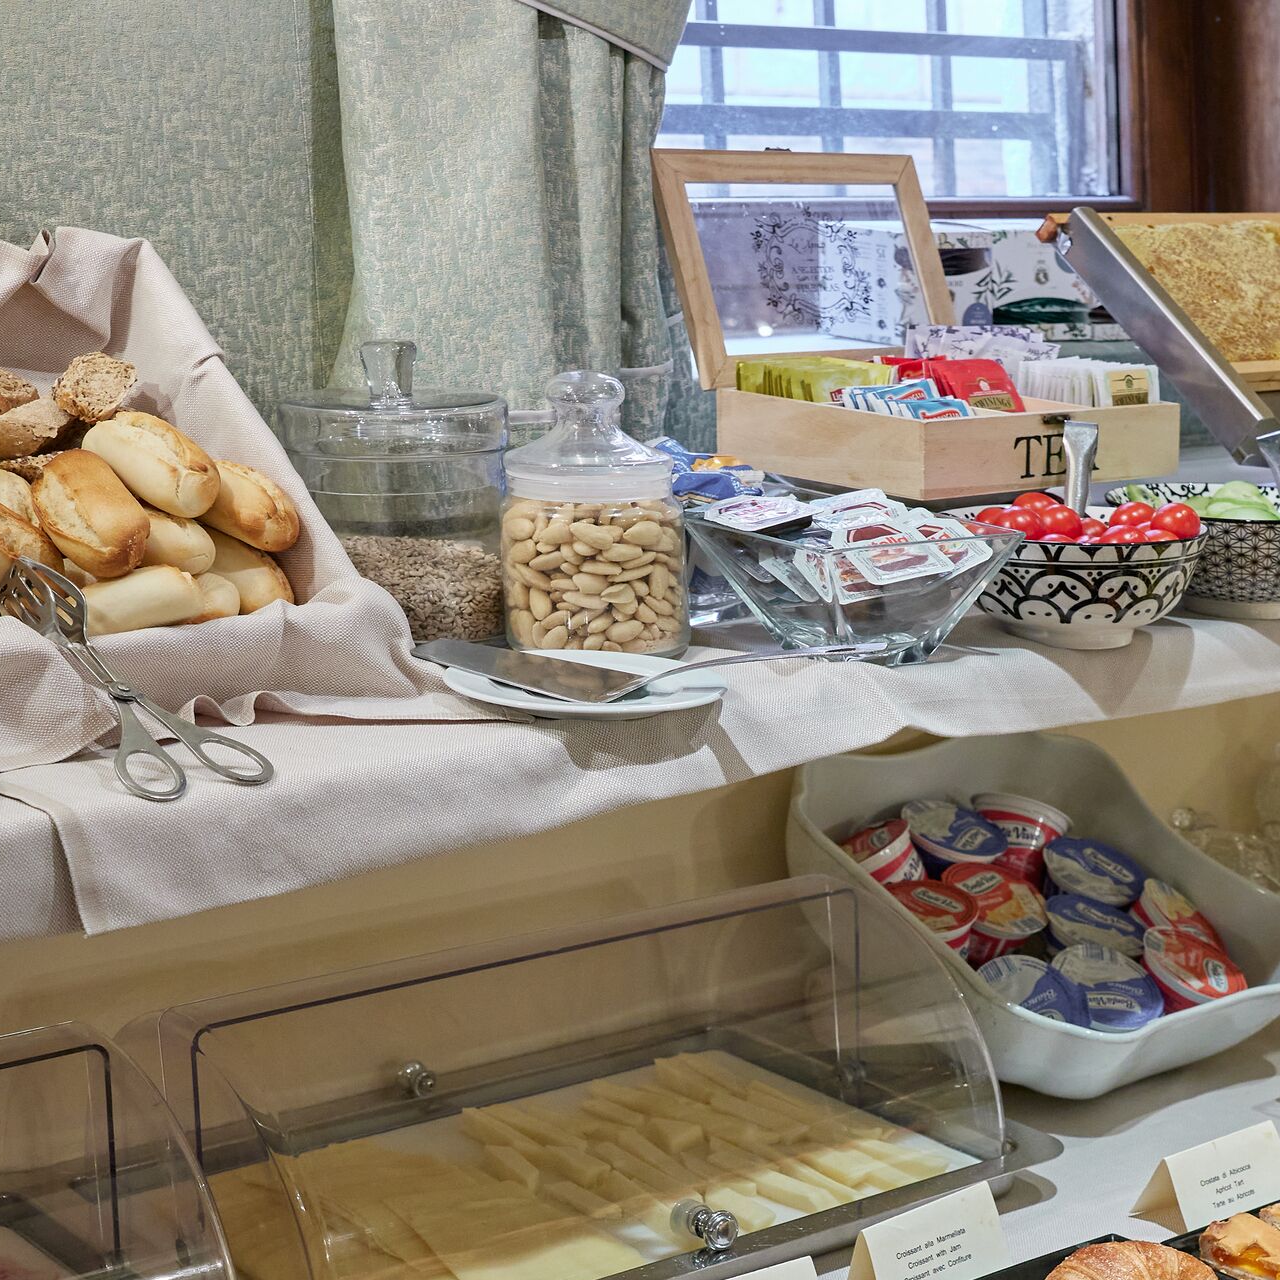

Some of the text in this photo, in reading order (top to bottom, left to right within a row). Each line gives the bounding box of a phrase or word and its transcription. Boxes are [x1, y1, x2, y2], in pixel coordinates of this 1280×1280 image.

[1013, 433, 1100, 480] TE
[1216, 1184, 1232, 1194] Apricot
[896, 1227, 966, 1260] Croissant alla Marmellata
[907, 1243, 962, 1270] Croissant with Jam
[932, 1264, 946, 1274] avec
[947, 1253, 972, 1269] Confiture
